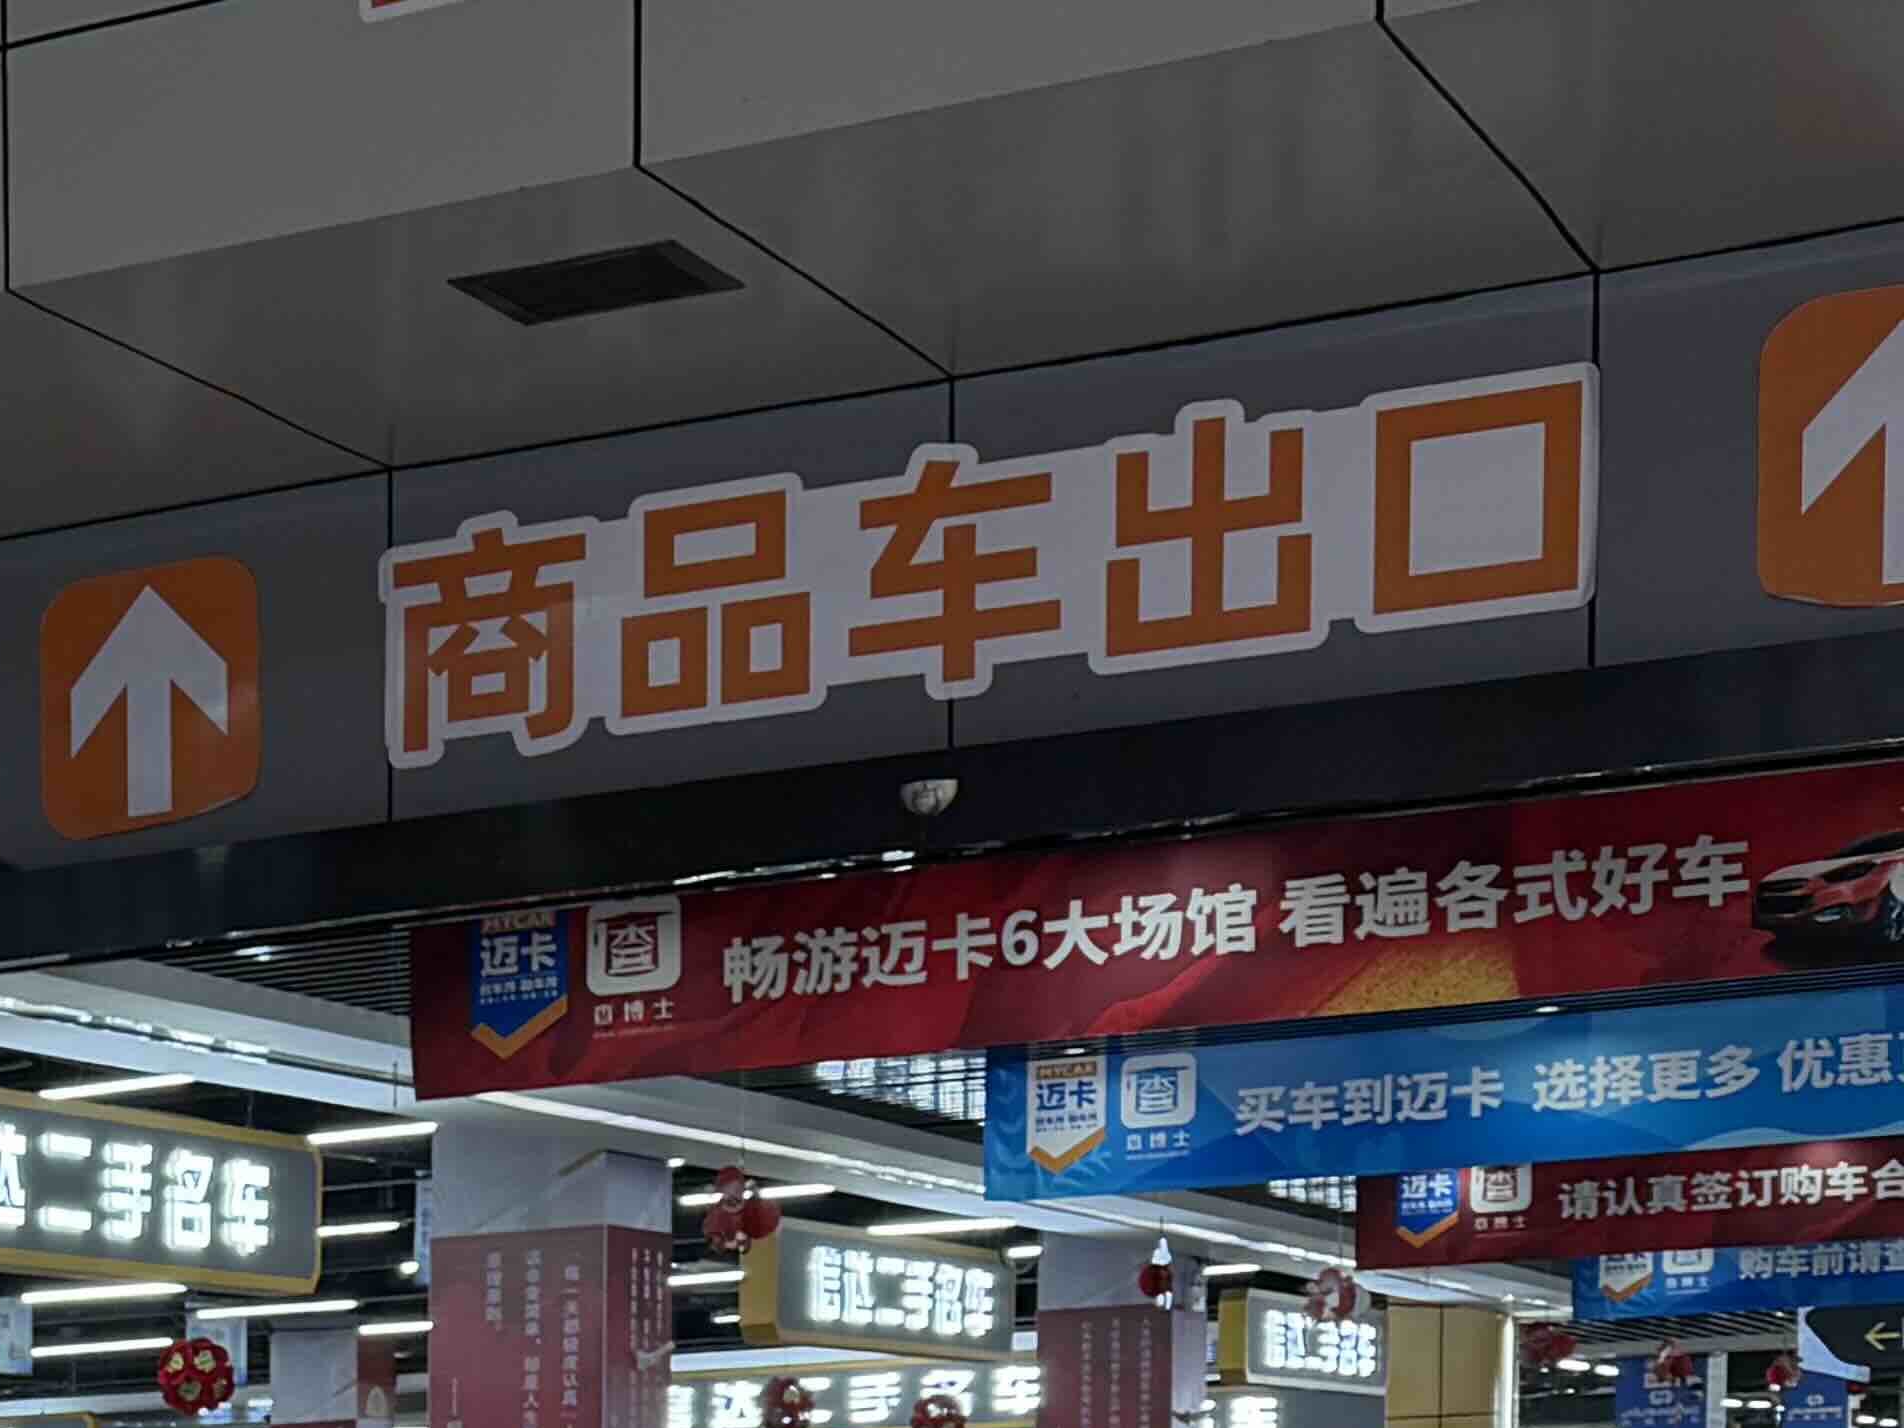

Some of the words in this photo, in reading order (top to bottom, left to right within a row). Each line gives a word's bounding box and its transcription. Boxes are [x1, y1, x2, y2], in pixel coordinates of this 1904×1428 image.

[392, 378, 1588, 755] 商品车出口
[480, 931, 557, 977] 迈卡
[722, 885, 1258, 1003] 畅游迈卡6大场馆
[1279, 838, 1750, 951] 看遍各式好车
[1036, 1080, 1097, 1110] 迈卡
[1236, 1060, 1504, 1136] 买车到迈卡
[1532, 1039, 1760, 1113] 选择更多
[1777, 1031, 1904, 1094] 优惠
[1400, 1173, 1453, 1201] 迈卡
[1558, 1159, 1904, 1221] 请认真签订购车合
[809, 1244, 996, 1338] 信达二手名车
